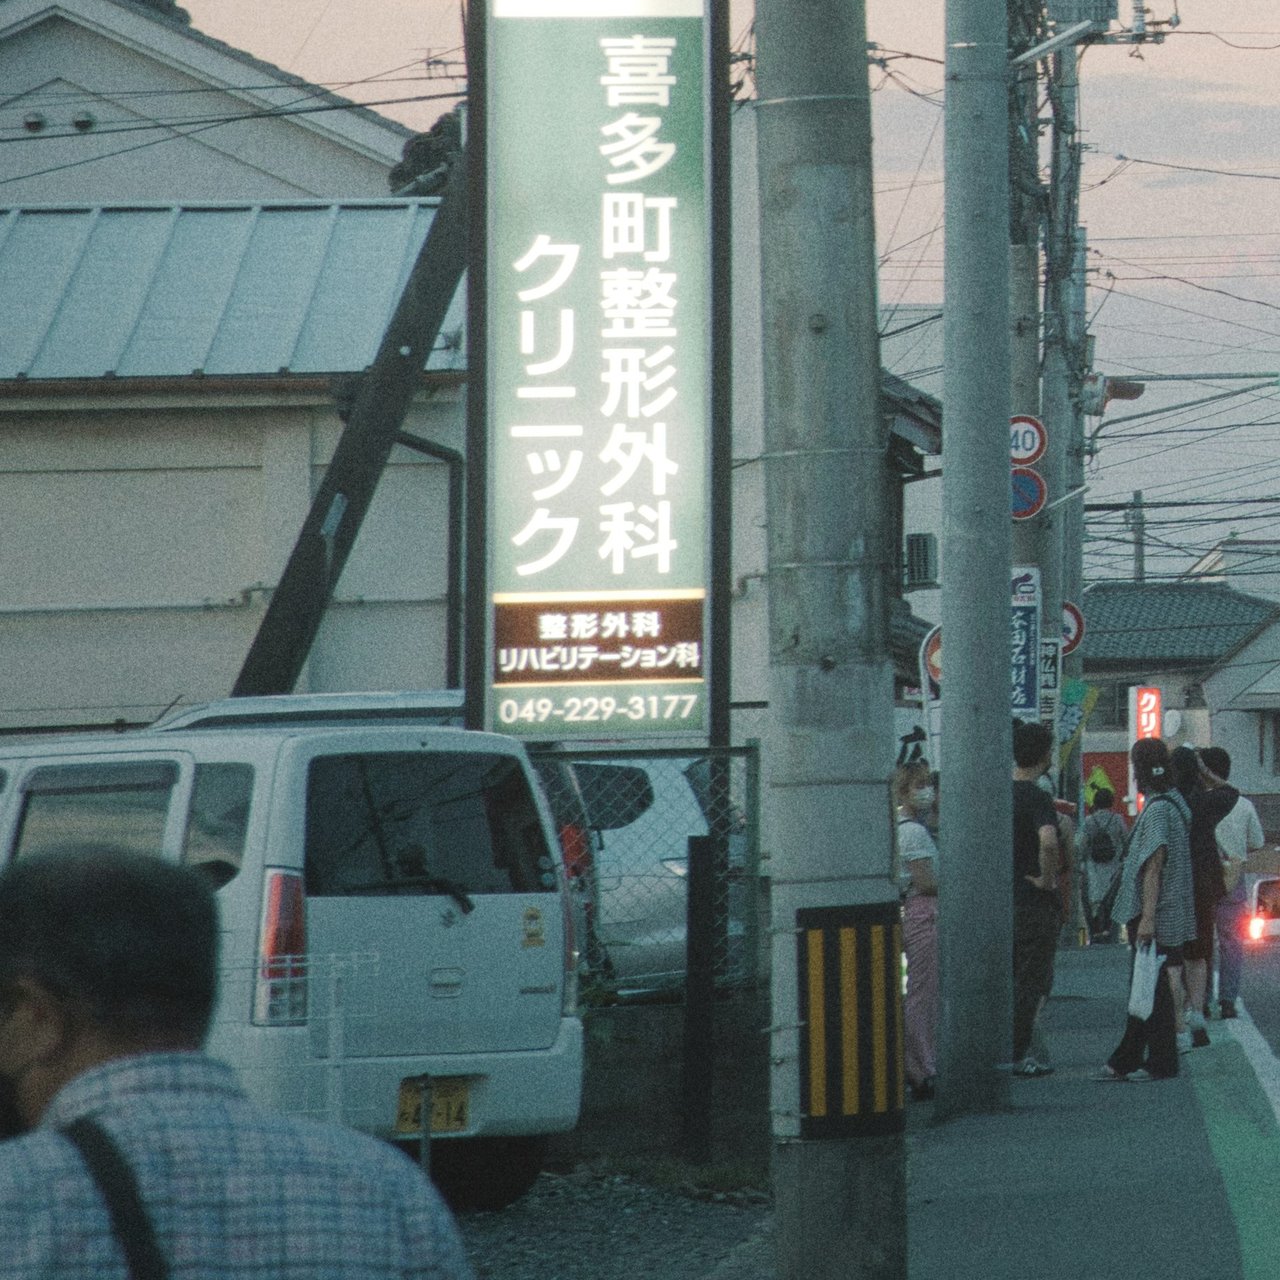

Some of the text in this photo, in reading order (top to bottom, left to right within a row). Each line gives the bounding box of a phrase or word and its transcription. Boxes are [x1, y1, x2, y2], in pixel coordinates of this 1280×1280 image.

[598, 33, 680, 576] 喜多町整形外科
[509, 234, 584, 577] クリニック
[1010, 430, 1036, 452] 40
[538, 611, 661, 640] 整形外科
[500, 642, 700, 672] リハビリテーション科
[500, 694, 698, 724] 049-229-3177
[1140, 692, 1157, 738] クリ
